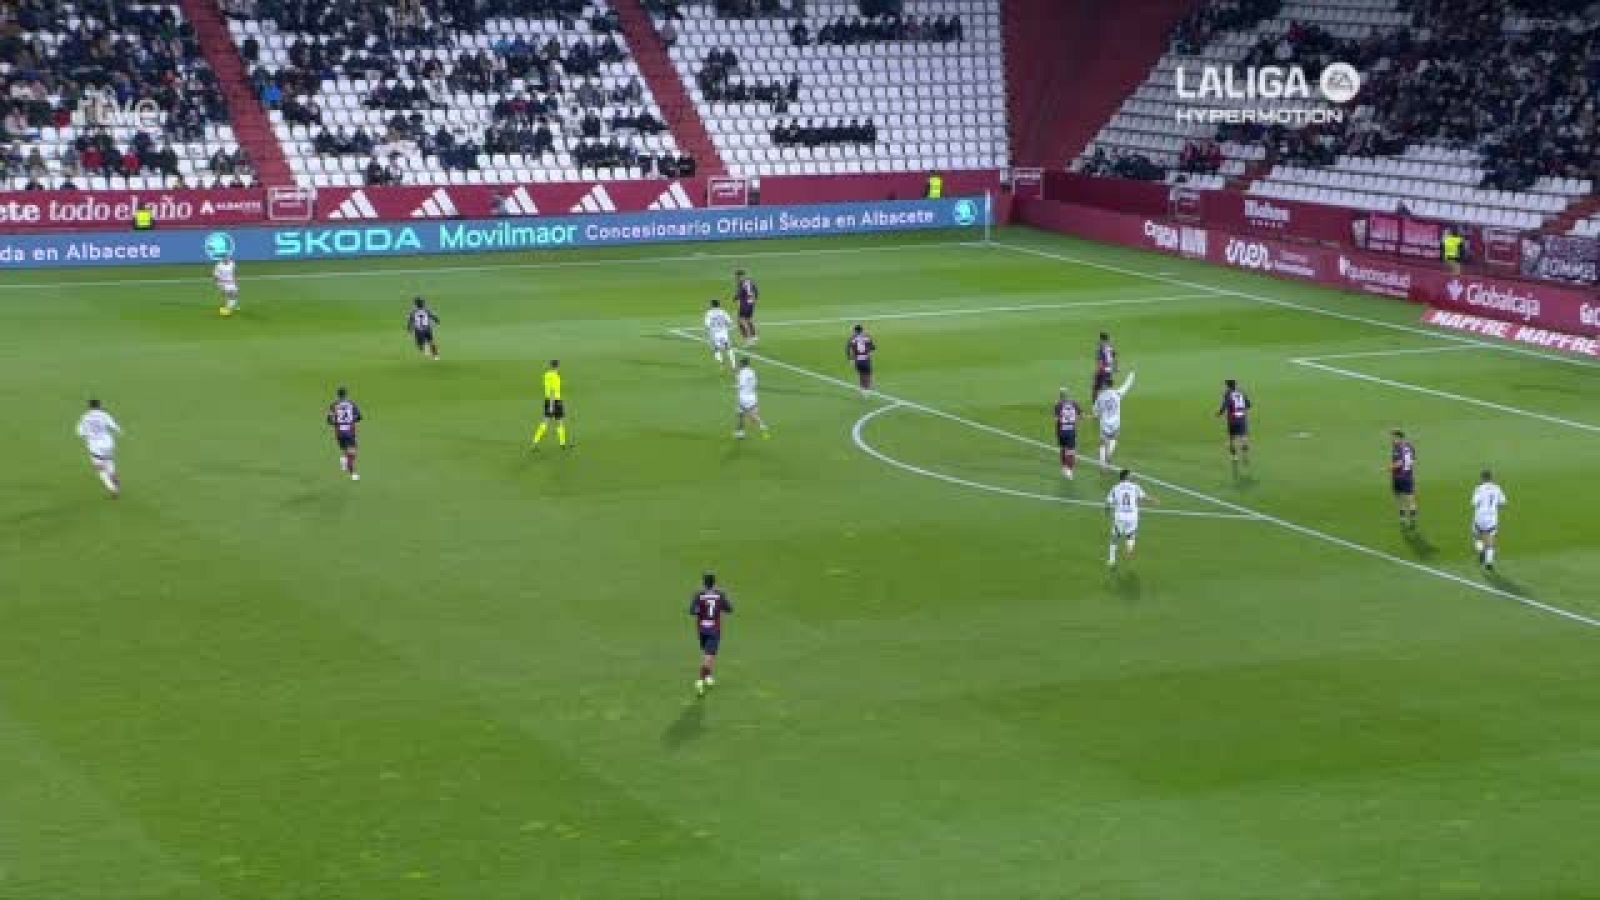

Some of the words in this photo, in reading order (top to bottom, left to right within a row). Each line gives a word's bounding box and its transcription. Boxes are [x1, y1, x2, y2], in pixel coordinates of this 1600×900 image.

[50, 196, 110, 221] todo
[439, 221, 578, 249] Movilmaor
[585, 220, 711, 240] Concesionario
[717, 216, 773, 233] Oficial
[779, 211, 832, 231] Škoda
[837, 214, 856, 227] en
[862, 209, 934, 225] Albacete
[0, 243, 25, 261] da
[33, 247, 58, 261] en
[66, 243, 161, 260] Albacete
[274, 226, 421, 254] SKODA
[1467, 284, 1541, 321] Globalcaja
[705, 599, 717, 618] 7
